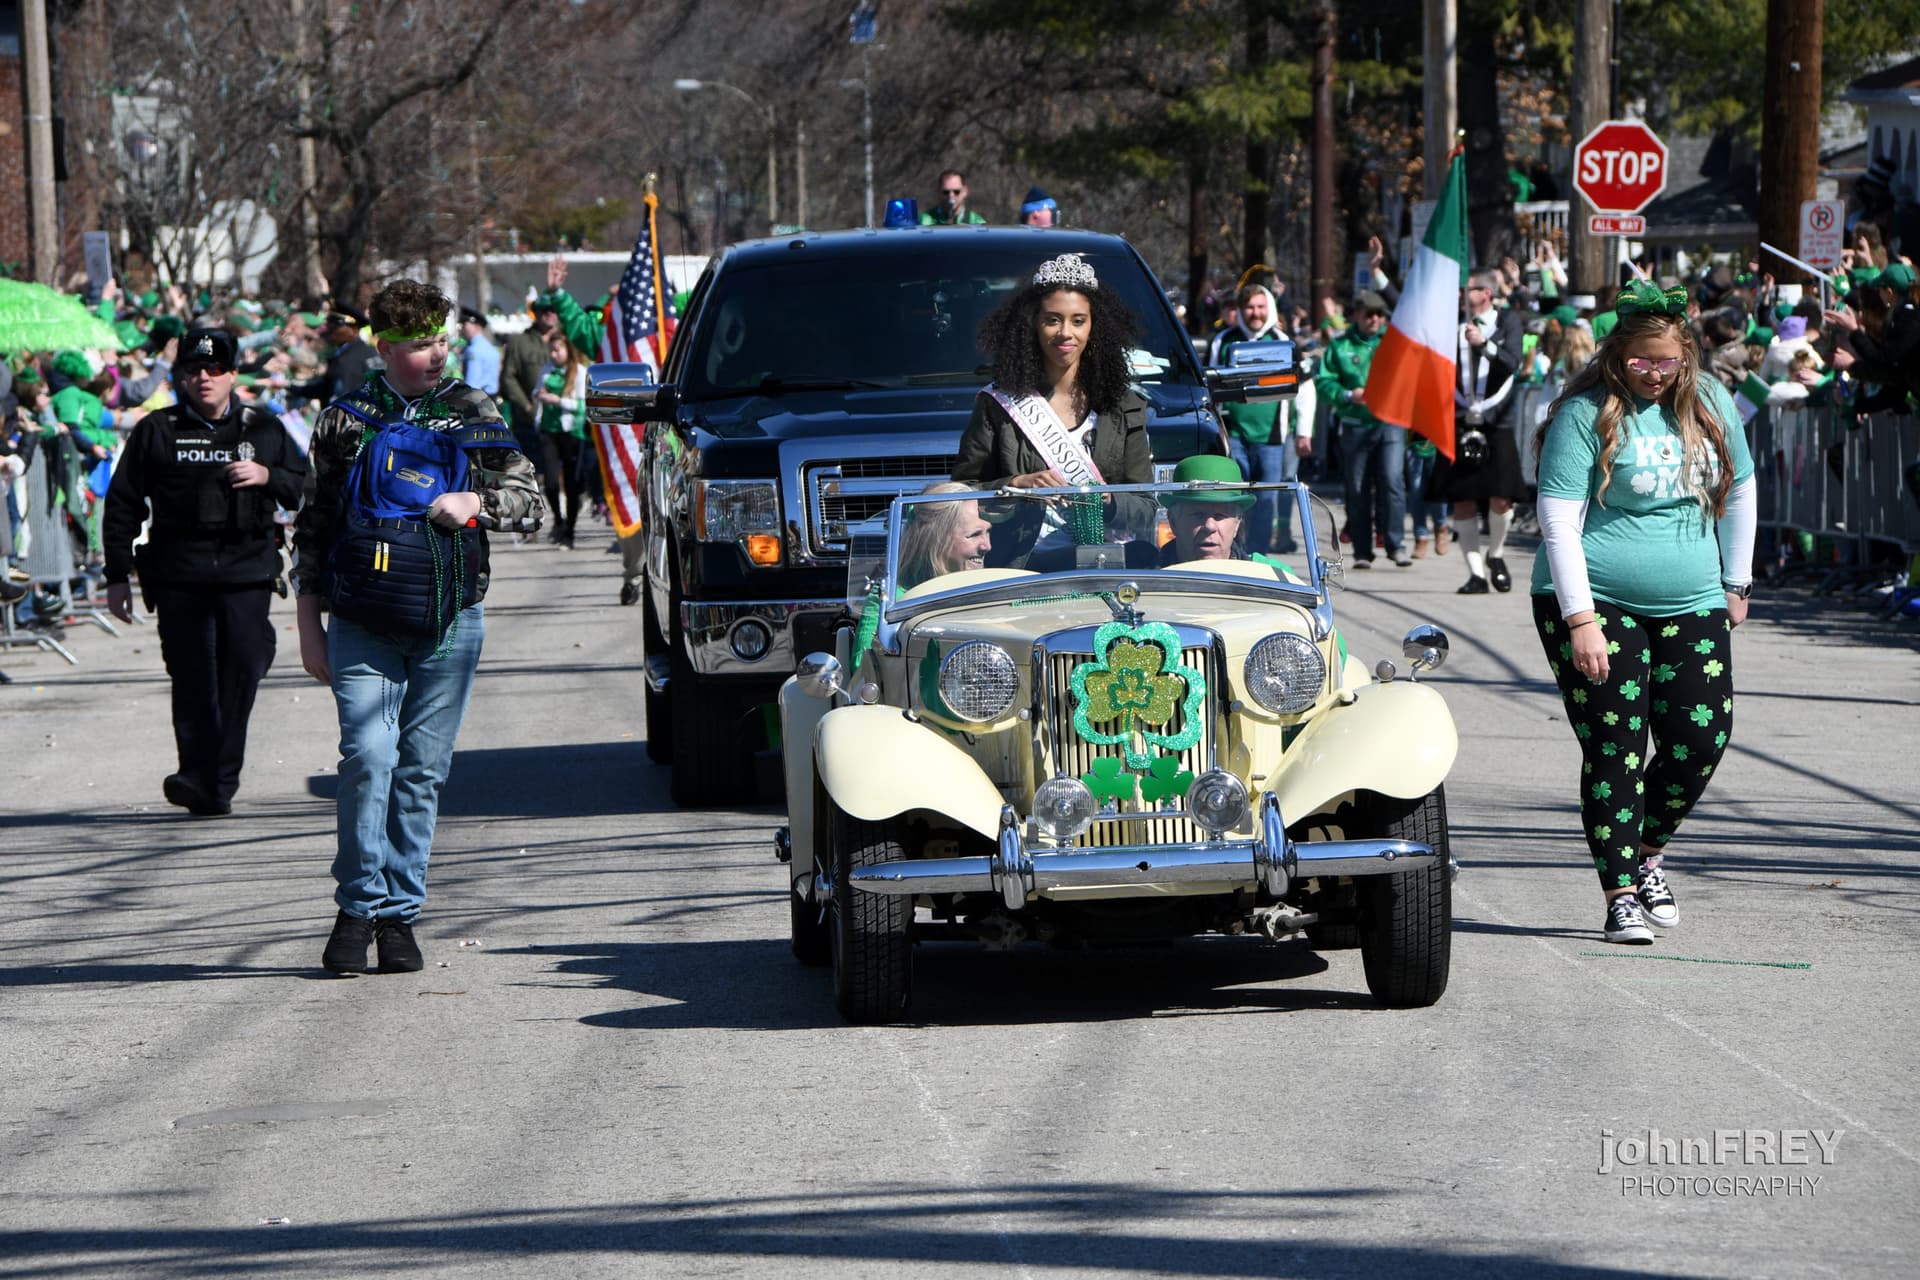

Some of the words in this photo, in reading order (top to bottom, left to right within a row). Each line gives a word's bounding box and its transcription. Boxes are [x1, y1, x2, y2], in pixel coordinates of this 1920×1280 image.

[1581, 149, 1661, 185] STOP
[1593, 218, 1614, 232] ALL
[1618, 218, 1641, 232] WAY
[176, 449, 233, 462] POLICE
